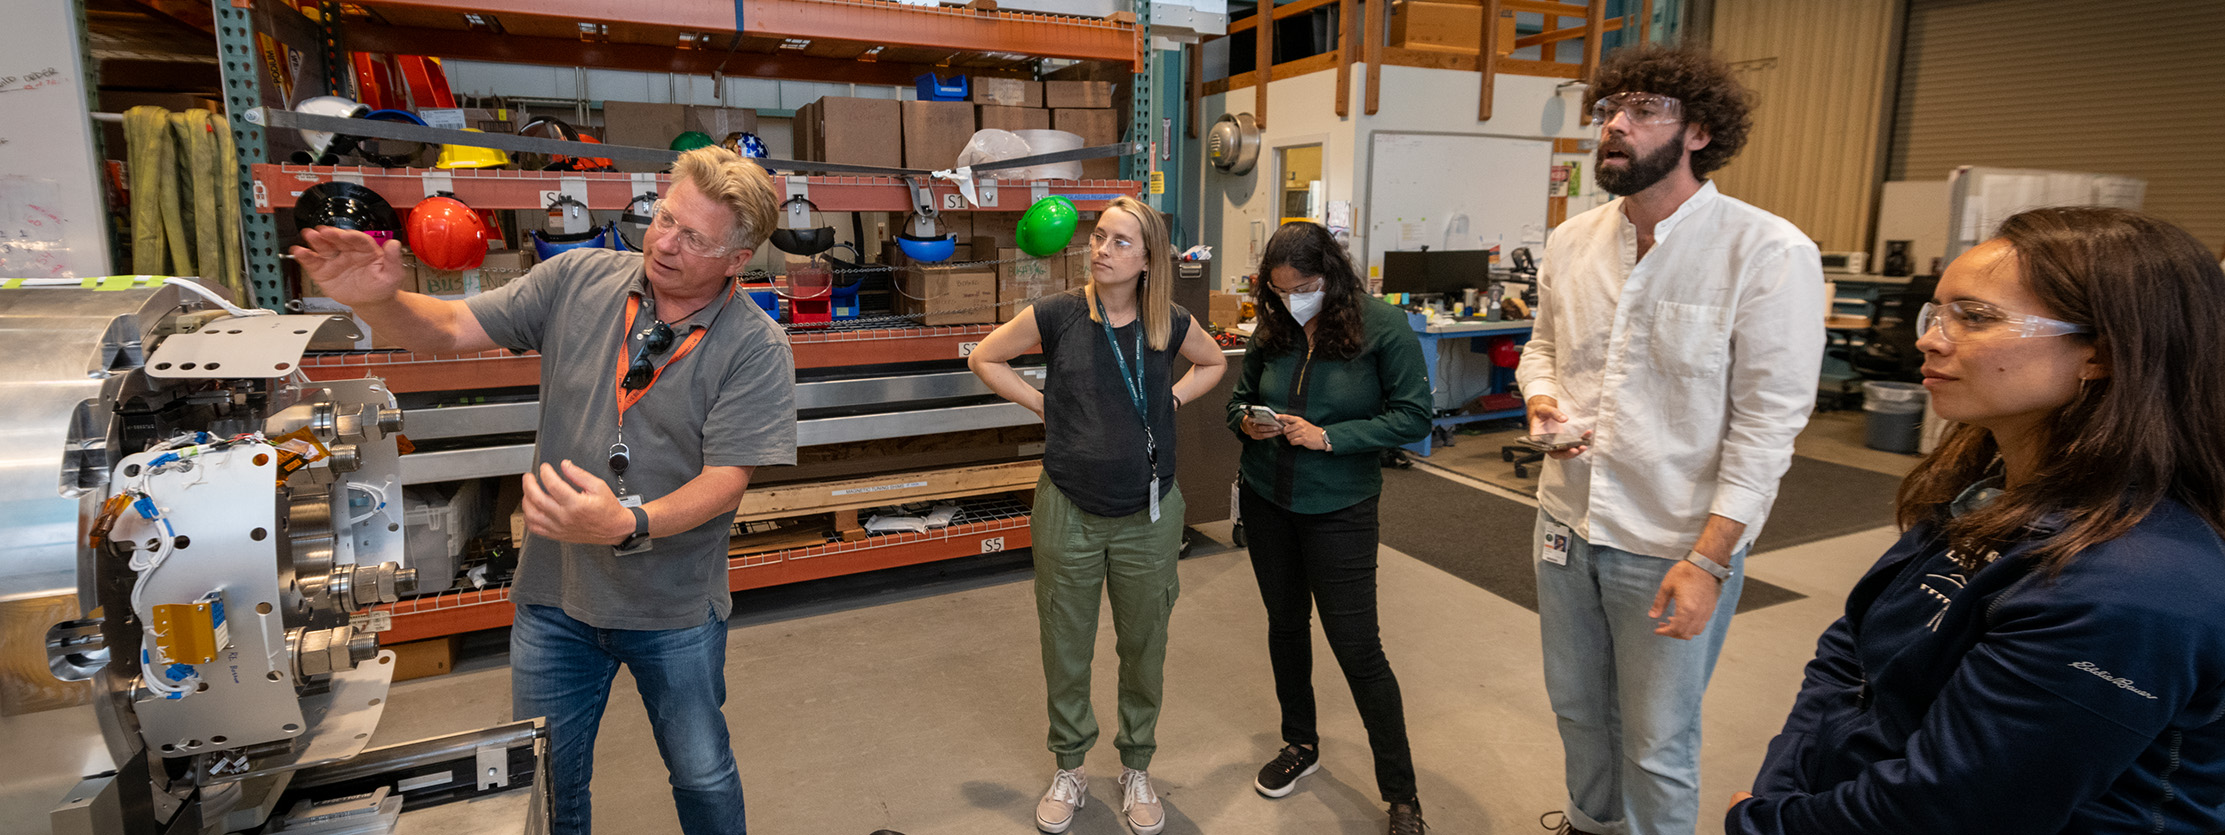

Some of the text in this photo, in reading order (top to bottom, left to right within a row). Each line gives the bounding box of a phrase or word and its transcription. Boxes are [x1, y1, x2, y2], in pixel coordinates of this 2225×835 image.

[265, 50, 281, 84] PODIUM
[948, 194, 965, 209] S1
[845, 487, 872, 495] MAGNETIC
[985, 537, 1002, 552] S5
